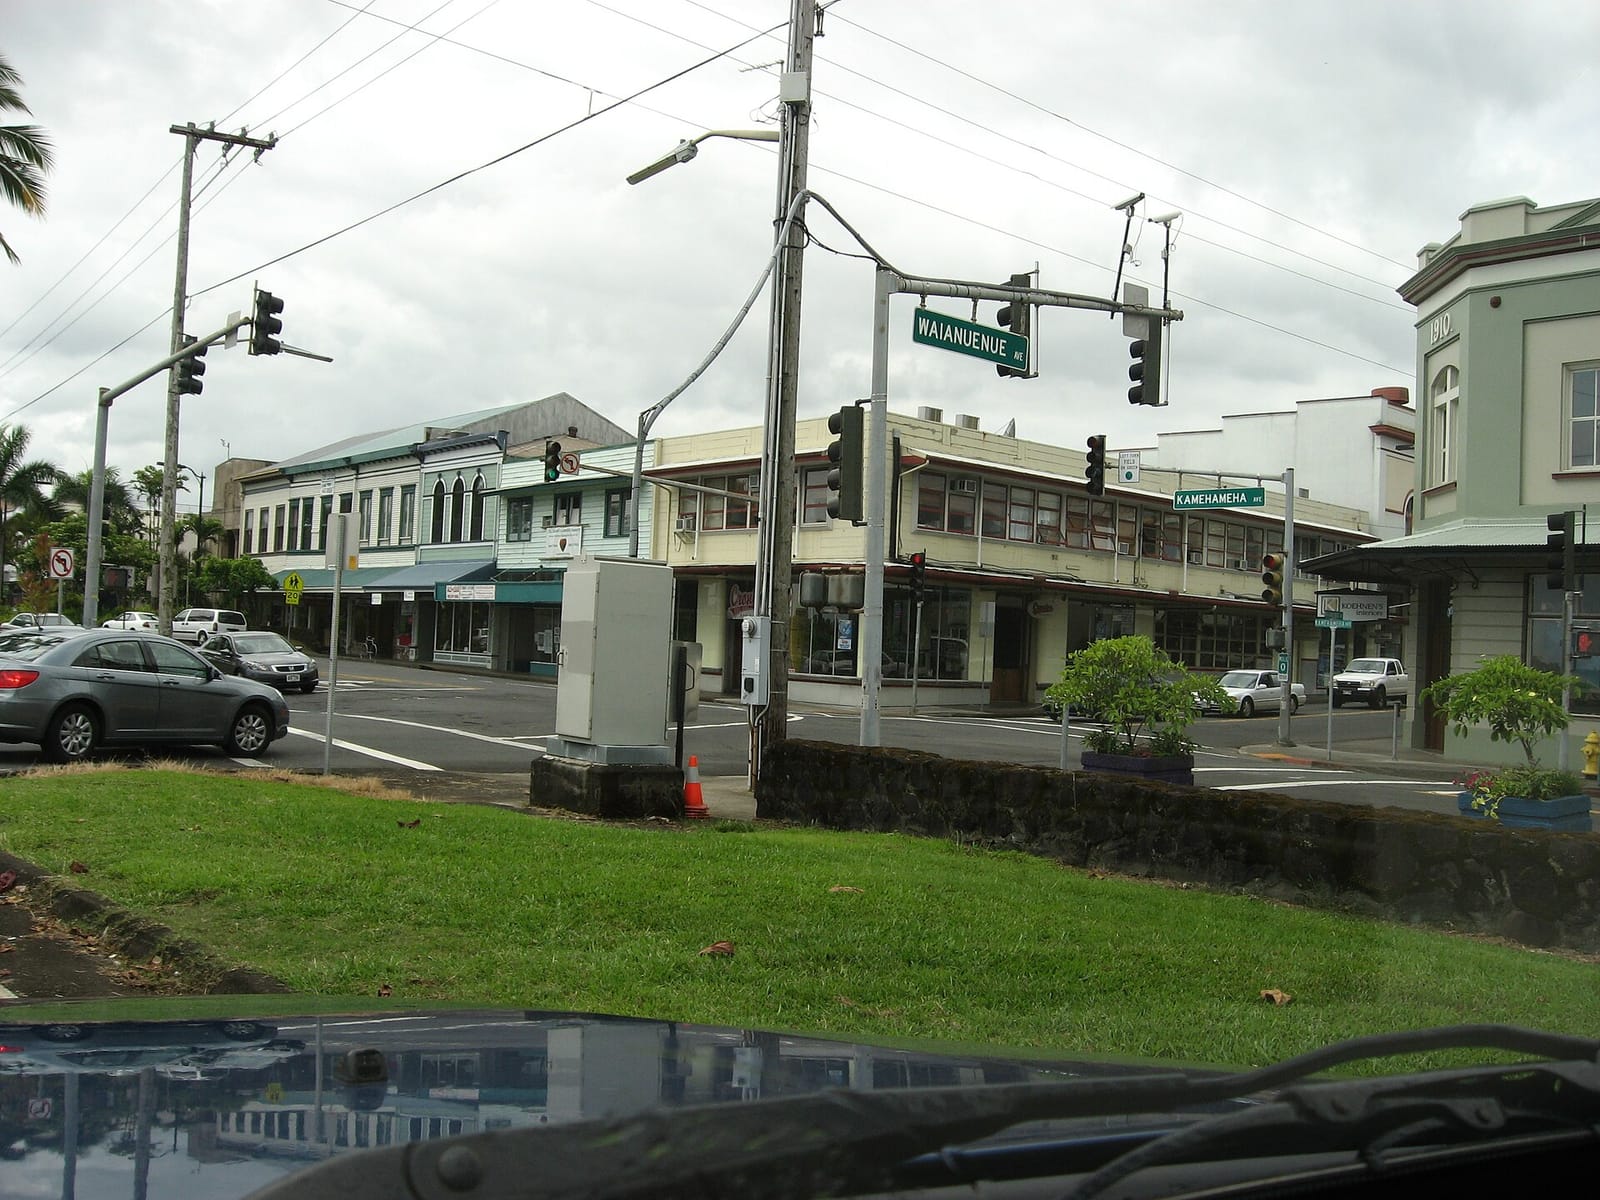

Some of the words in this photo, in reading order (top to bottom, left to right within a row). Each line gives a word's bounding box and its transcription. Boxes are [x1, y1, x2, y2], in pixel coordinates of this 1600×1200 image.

[918, 316, 1007, 357] WAIANUENUE
[1013, 350, 1024, 361] AVE
[1176, 492, 1247, 505] KAMEHAMEHA
[1253, 495, 1263, 503] AVE
